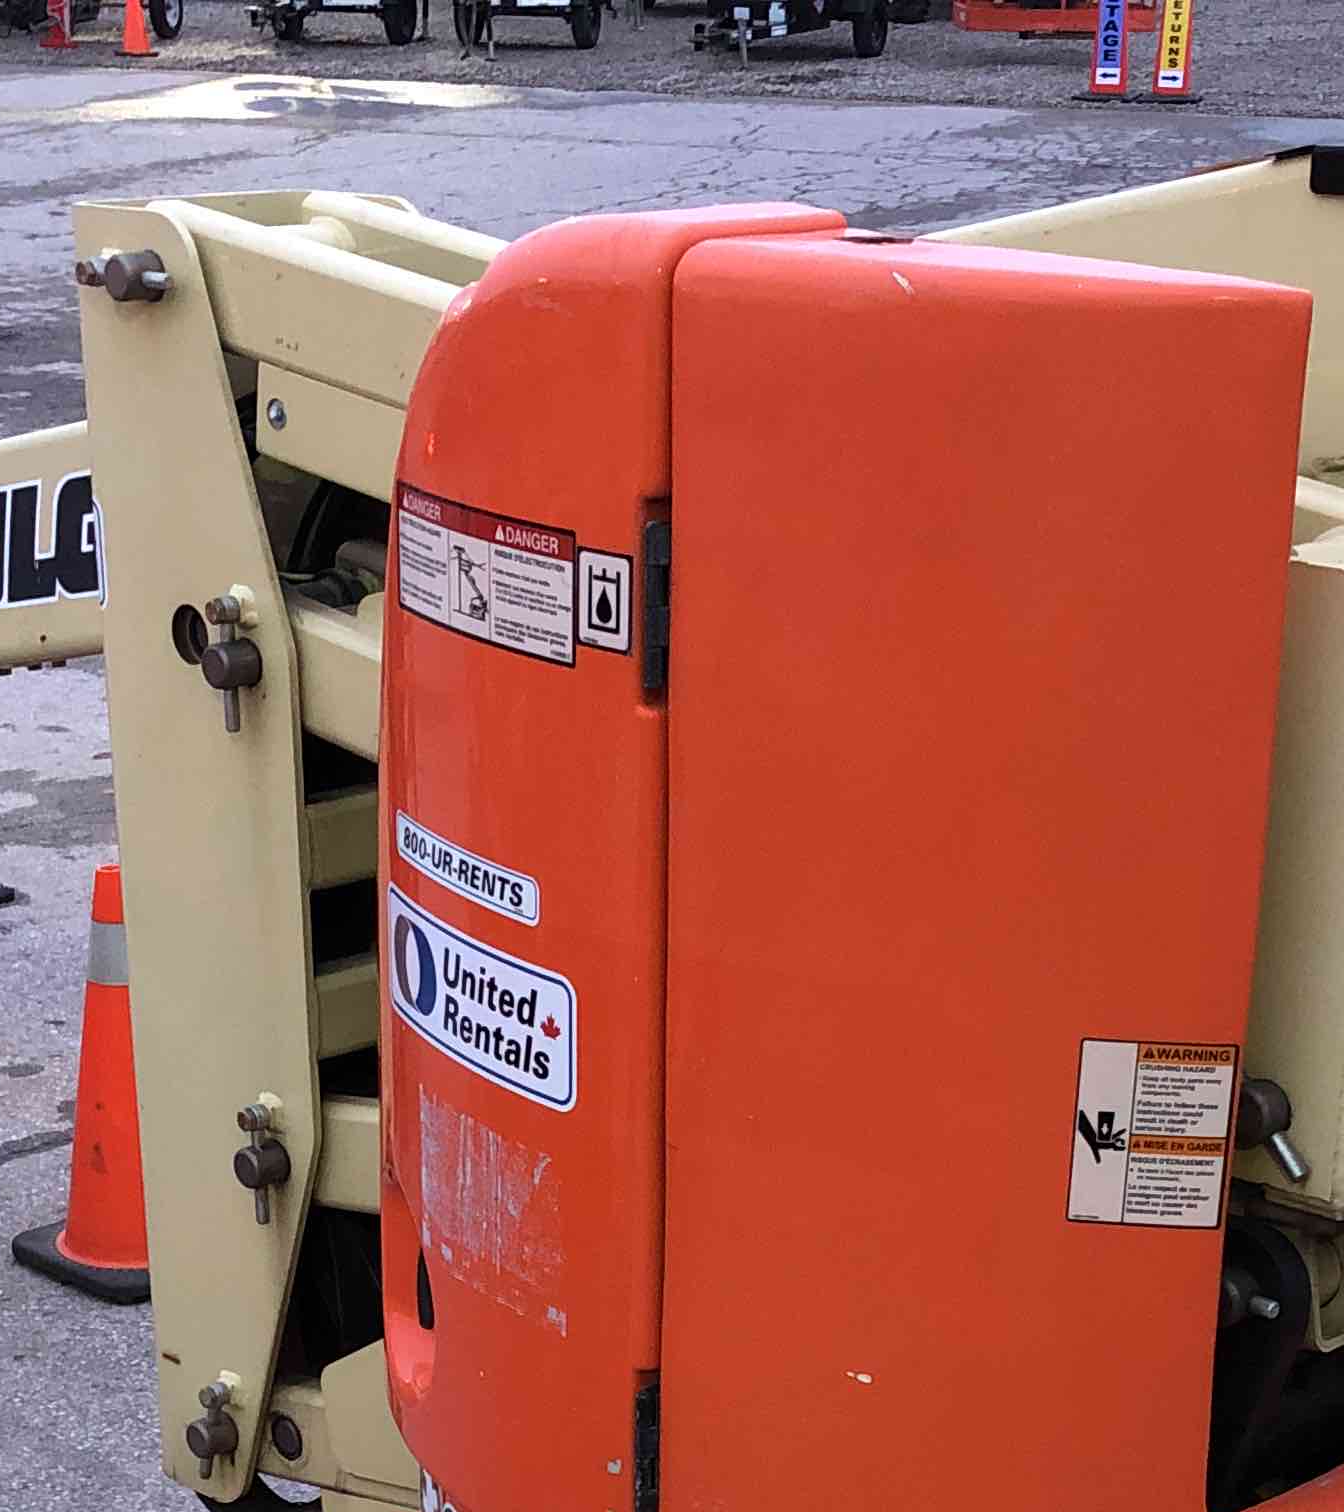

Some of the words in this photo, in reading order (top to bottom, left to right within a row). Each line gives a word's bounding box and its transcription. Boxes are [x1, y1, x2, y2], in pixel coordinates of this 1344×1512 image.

[1102, 0, 1121, 62] TAGE
[505, 525, 559, 556] DANGER
[403, 826, 524, 908] 800-UR-RENTS
[443, 946, 538, 1028] United
[443, 993, 550, 1080] Rentals
[1157, 1047, 1231, 1062] WARNING
